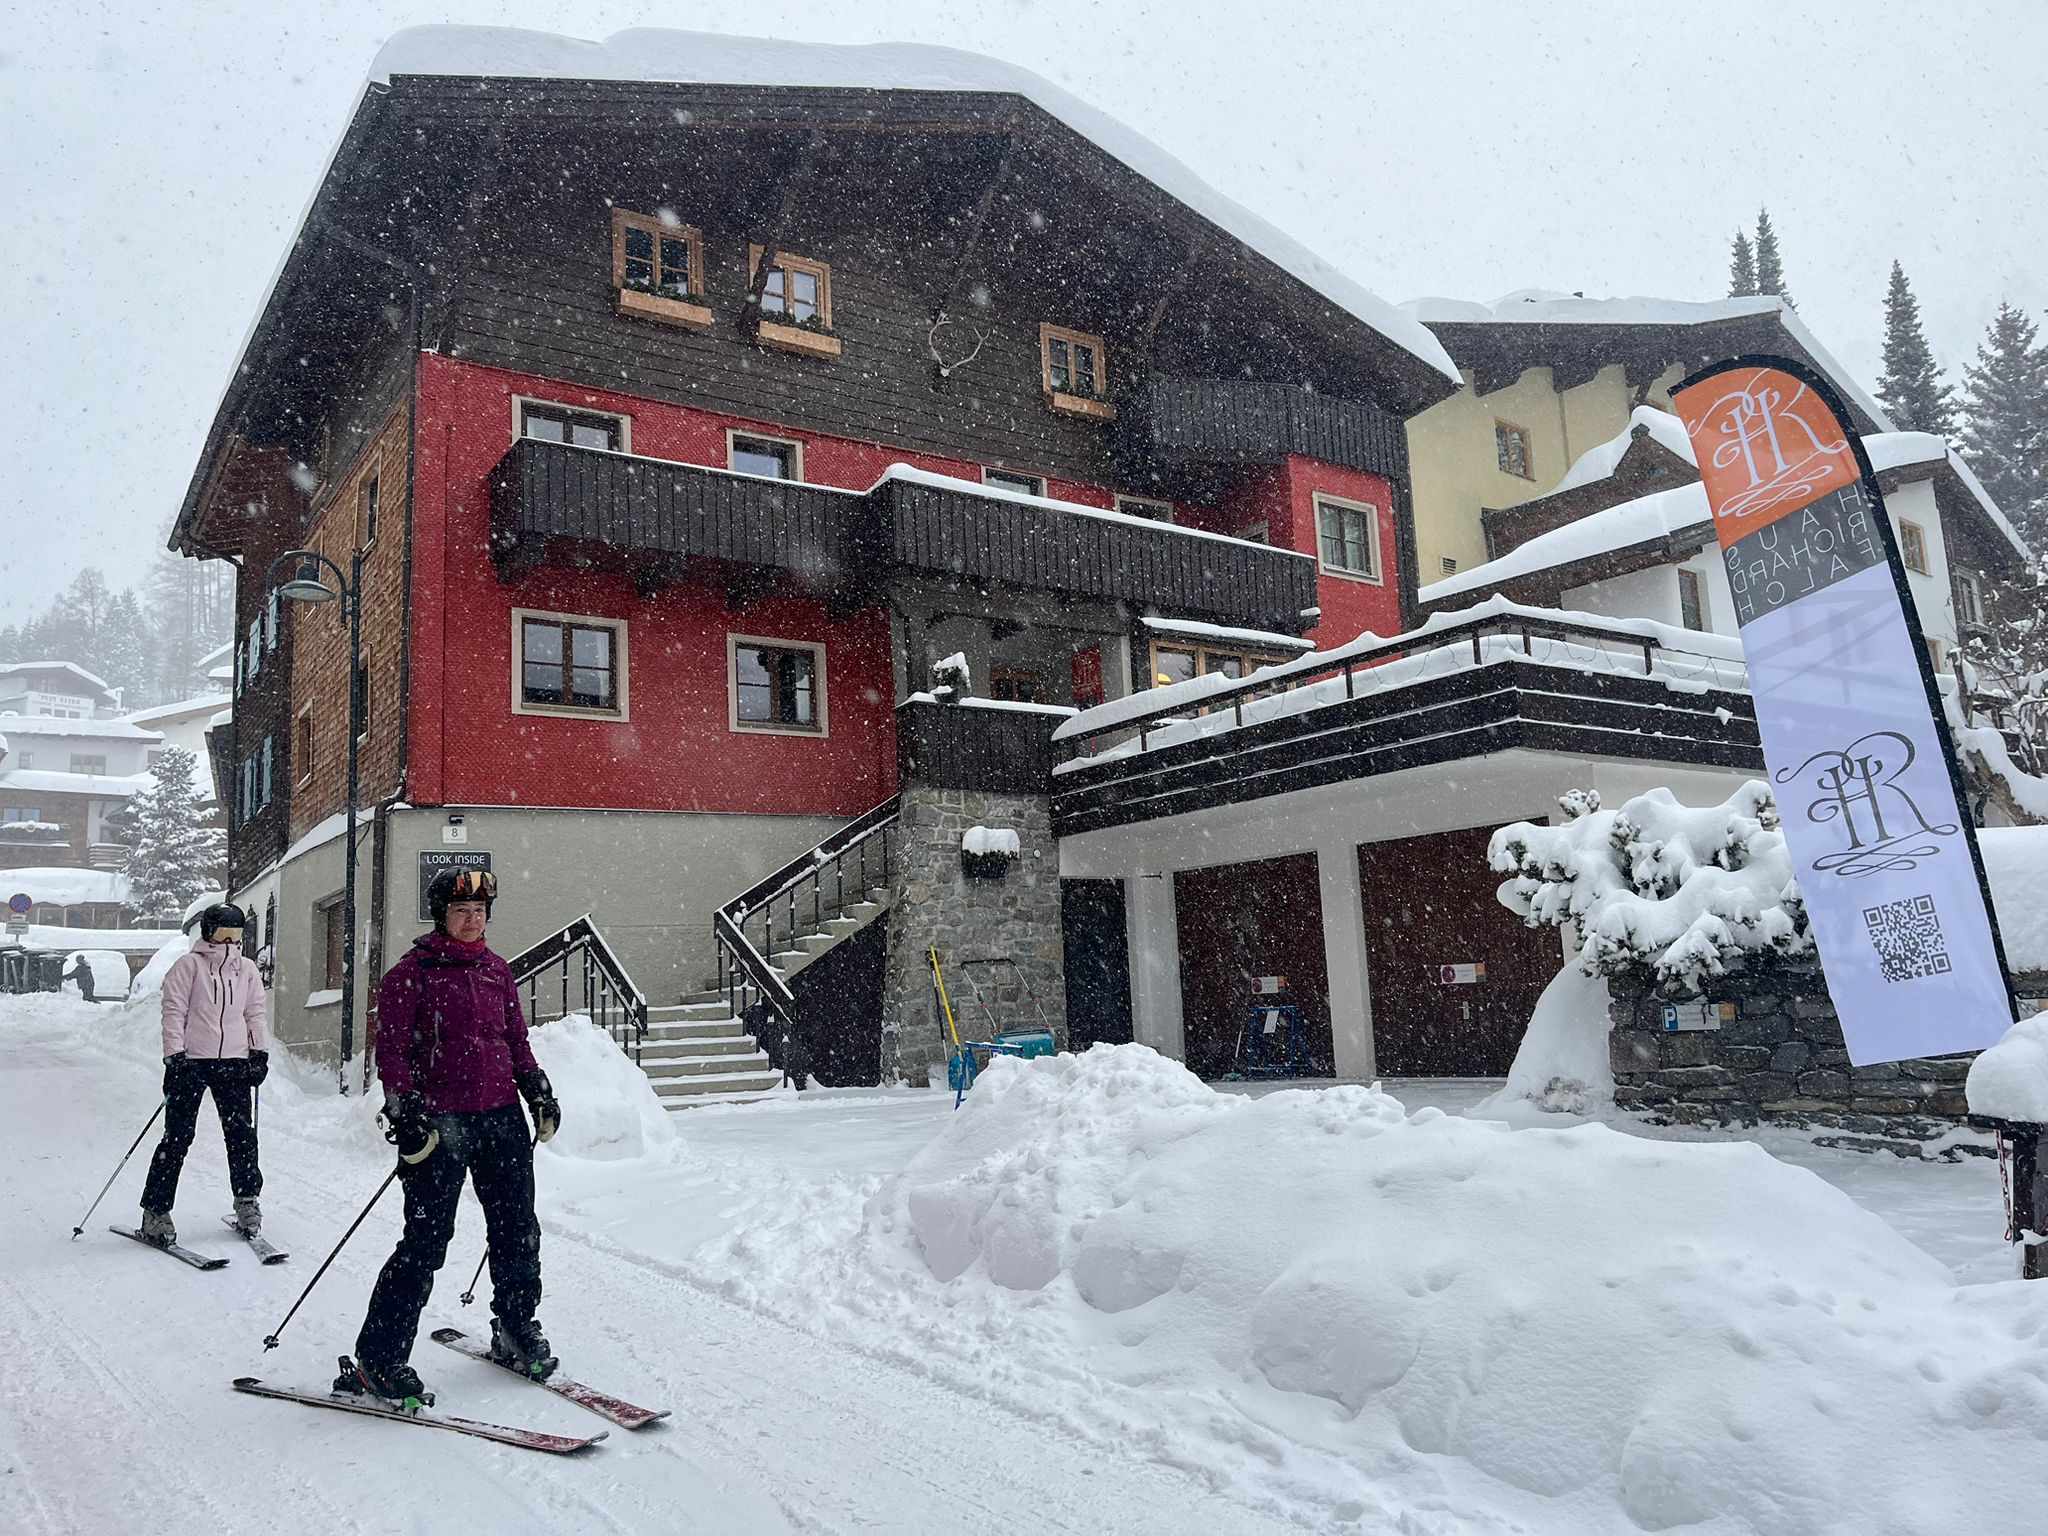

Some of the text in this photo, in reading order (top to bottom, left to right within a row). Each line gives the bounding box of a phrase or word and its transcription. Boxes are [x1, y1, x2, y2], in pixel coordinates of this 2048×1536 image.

[451, 828, 458, 837] 8
[426, 855, 452, 864] LOOK
[1664, 1008, 1676, 1028] P
